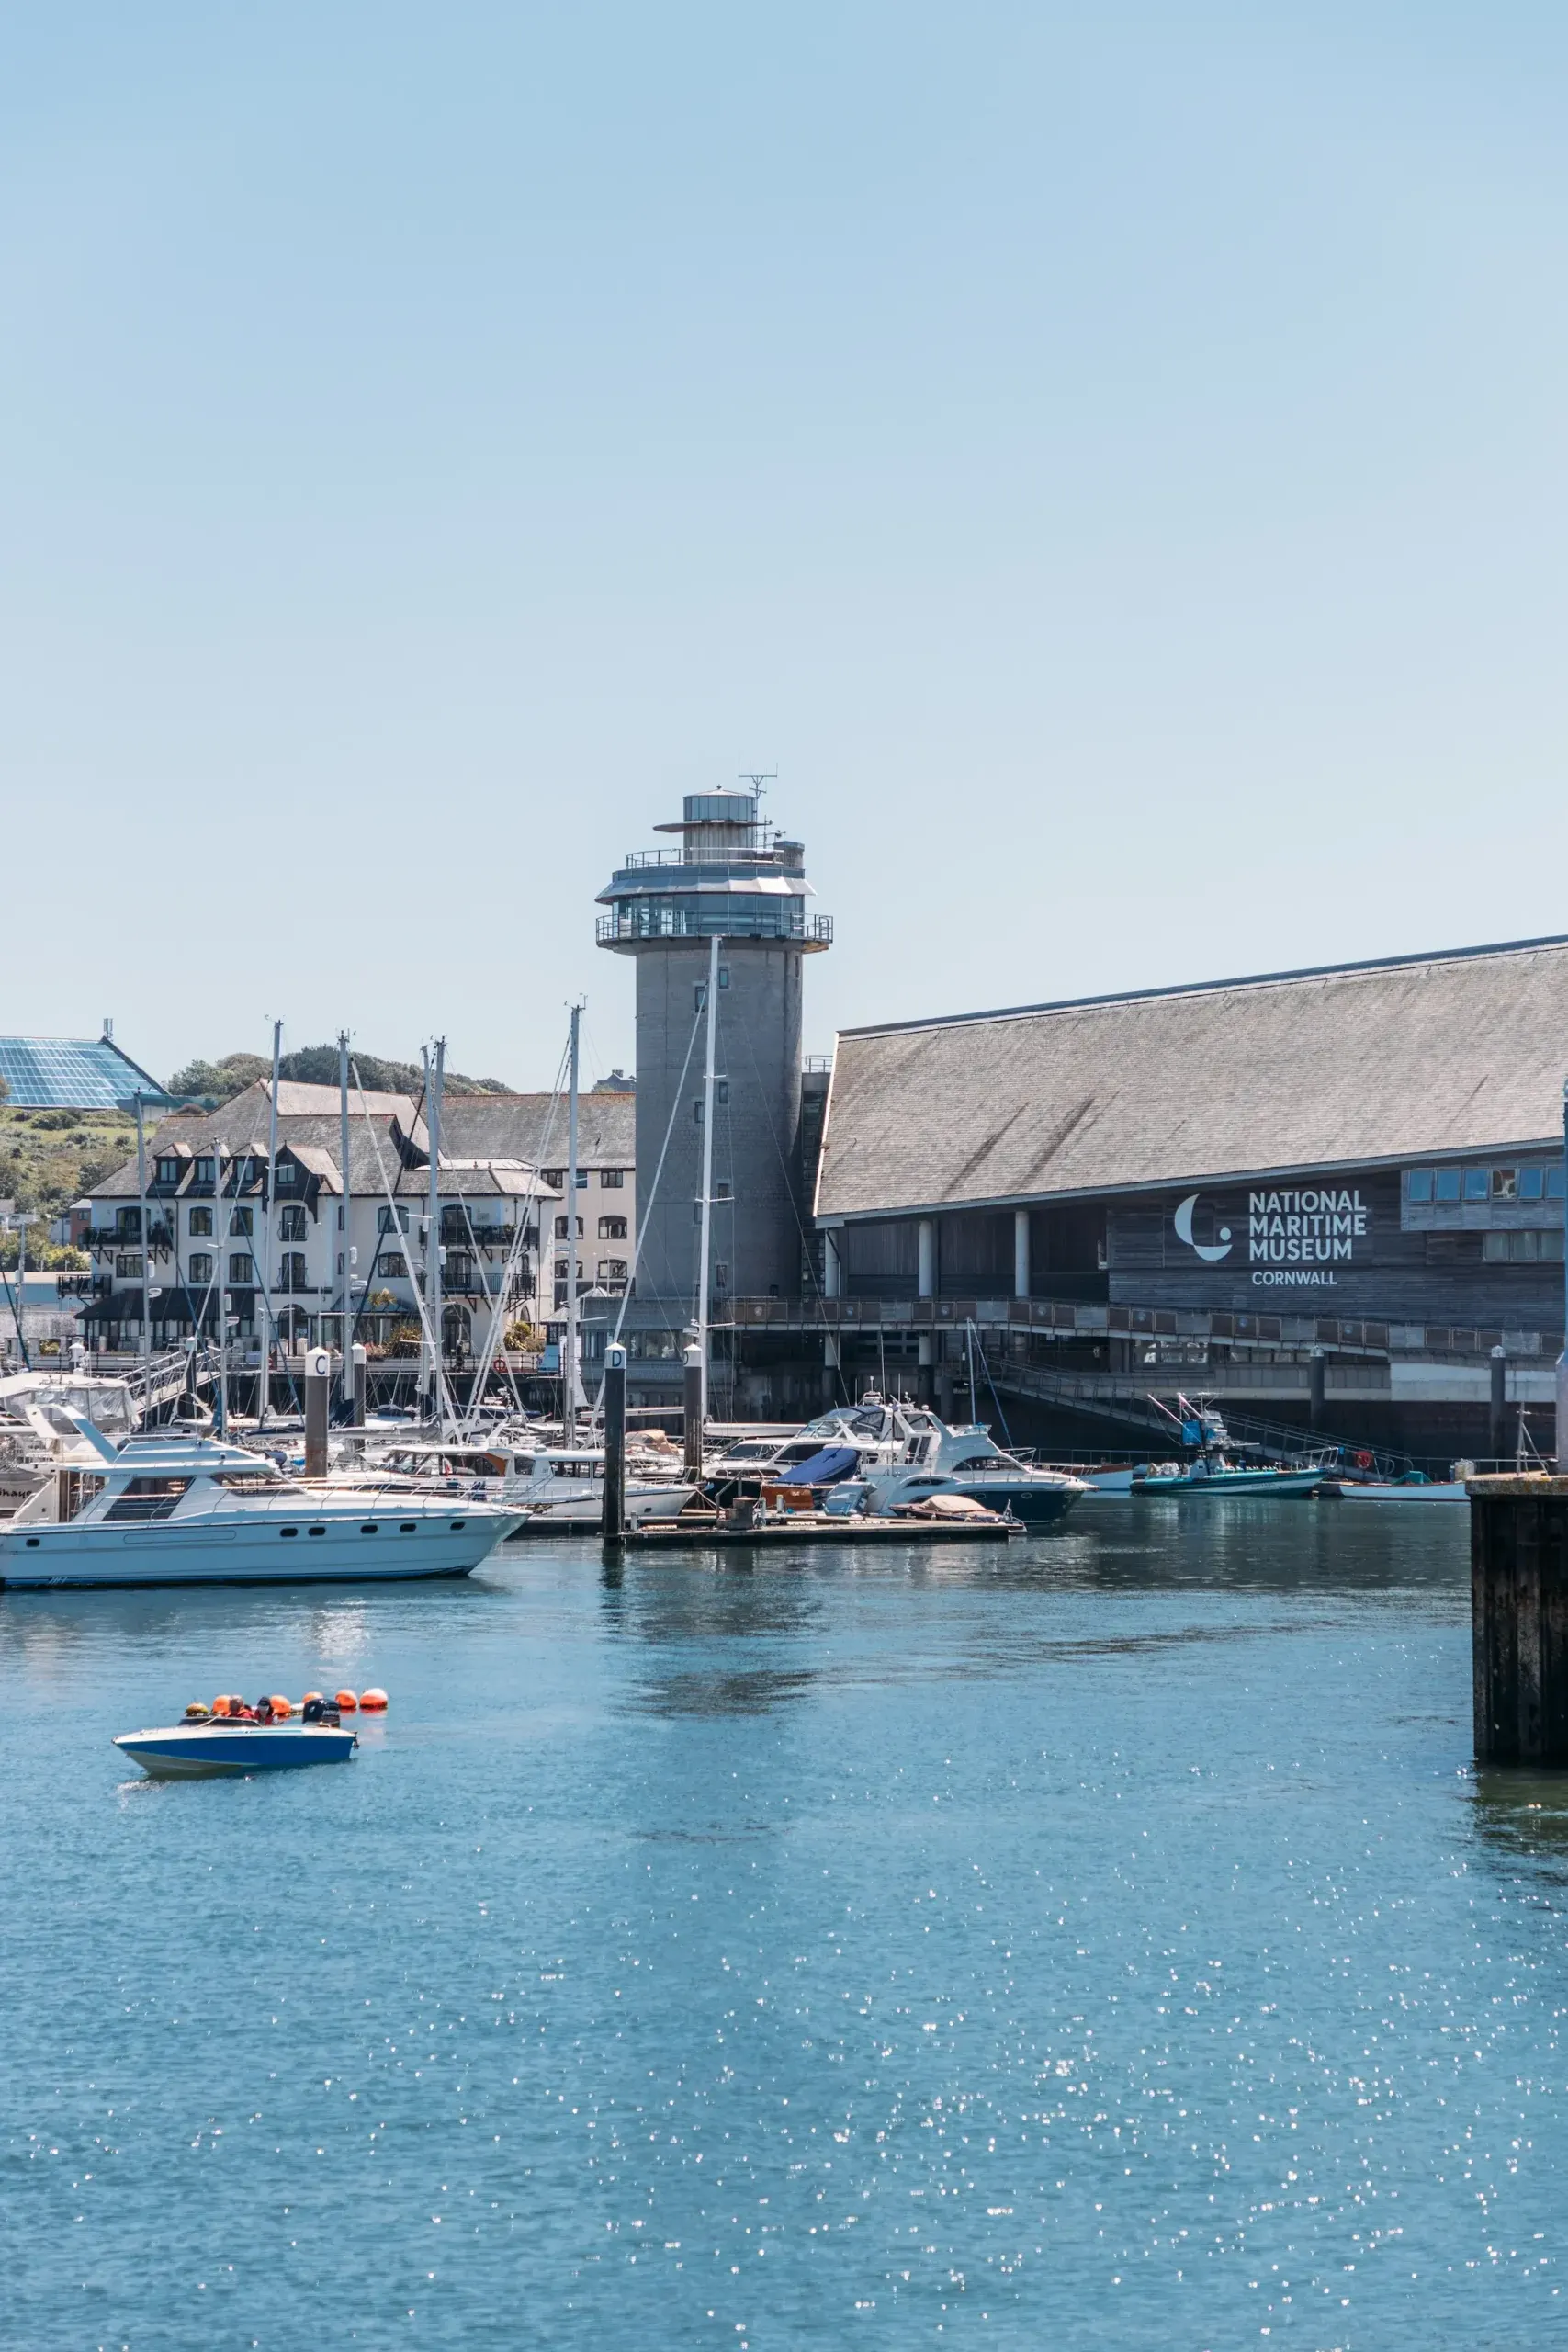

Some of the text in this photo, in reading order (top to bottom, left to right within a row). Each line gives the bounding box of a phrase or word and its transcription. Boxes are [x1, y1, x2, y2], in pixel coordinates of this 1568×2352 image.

[1249, 1190, 1367, 1213] NATIONAL
[1249, 1214, 1367, 1237] MARITIME
[1249, 1238, 1353, 1261] MUSEUM
[1252, 1271, 1338, 1286] CORNWALL
[315, 1355, 326, 1375] C
[612, 1351, 622, 1367] D
